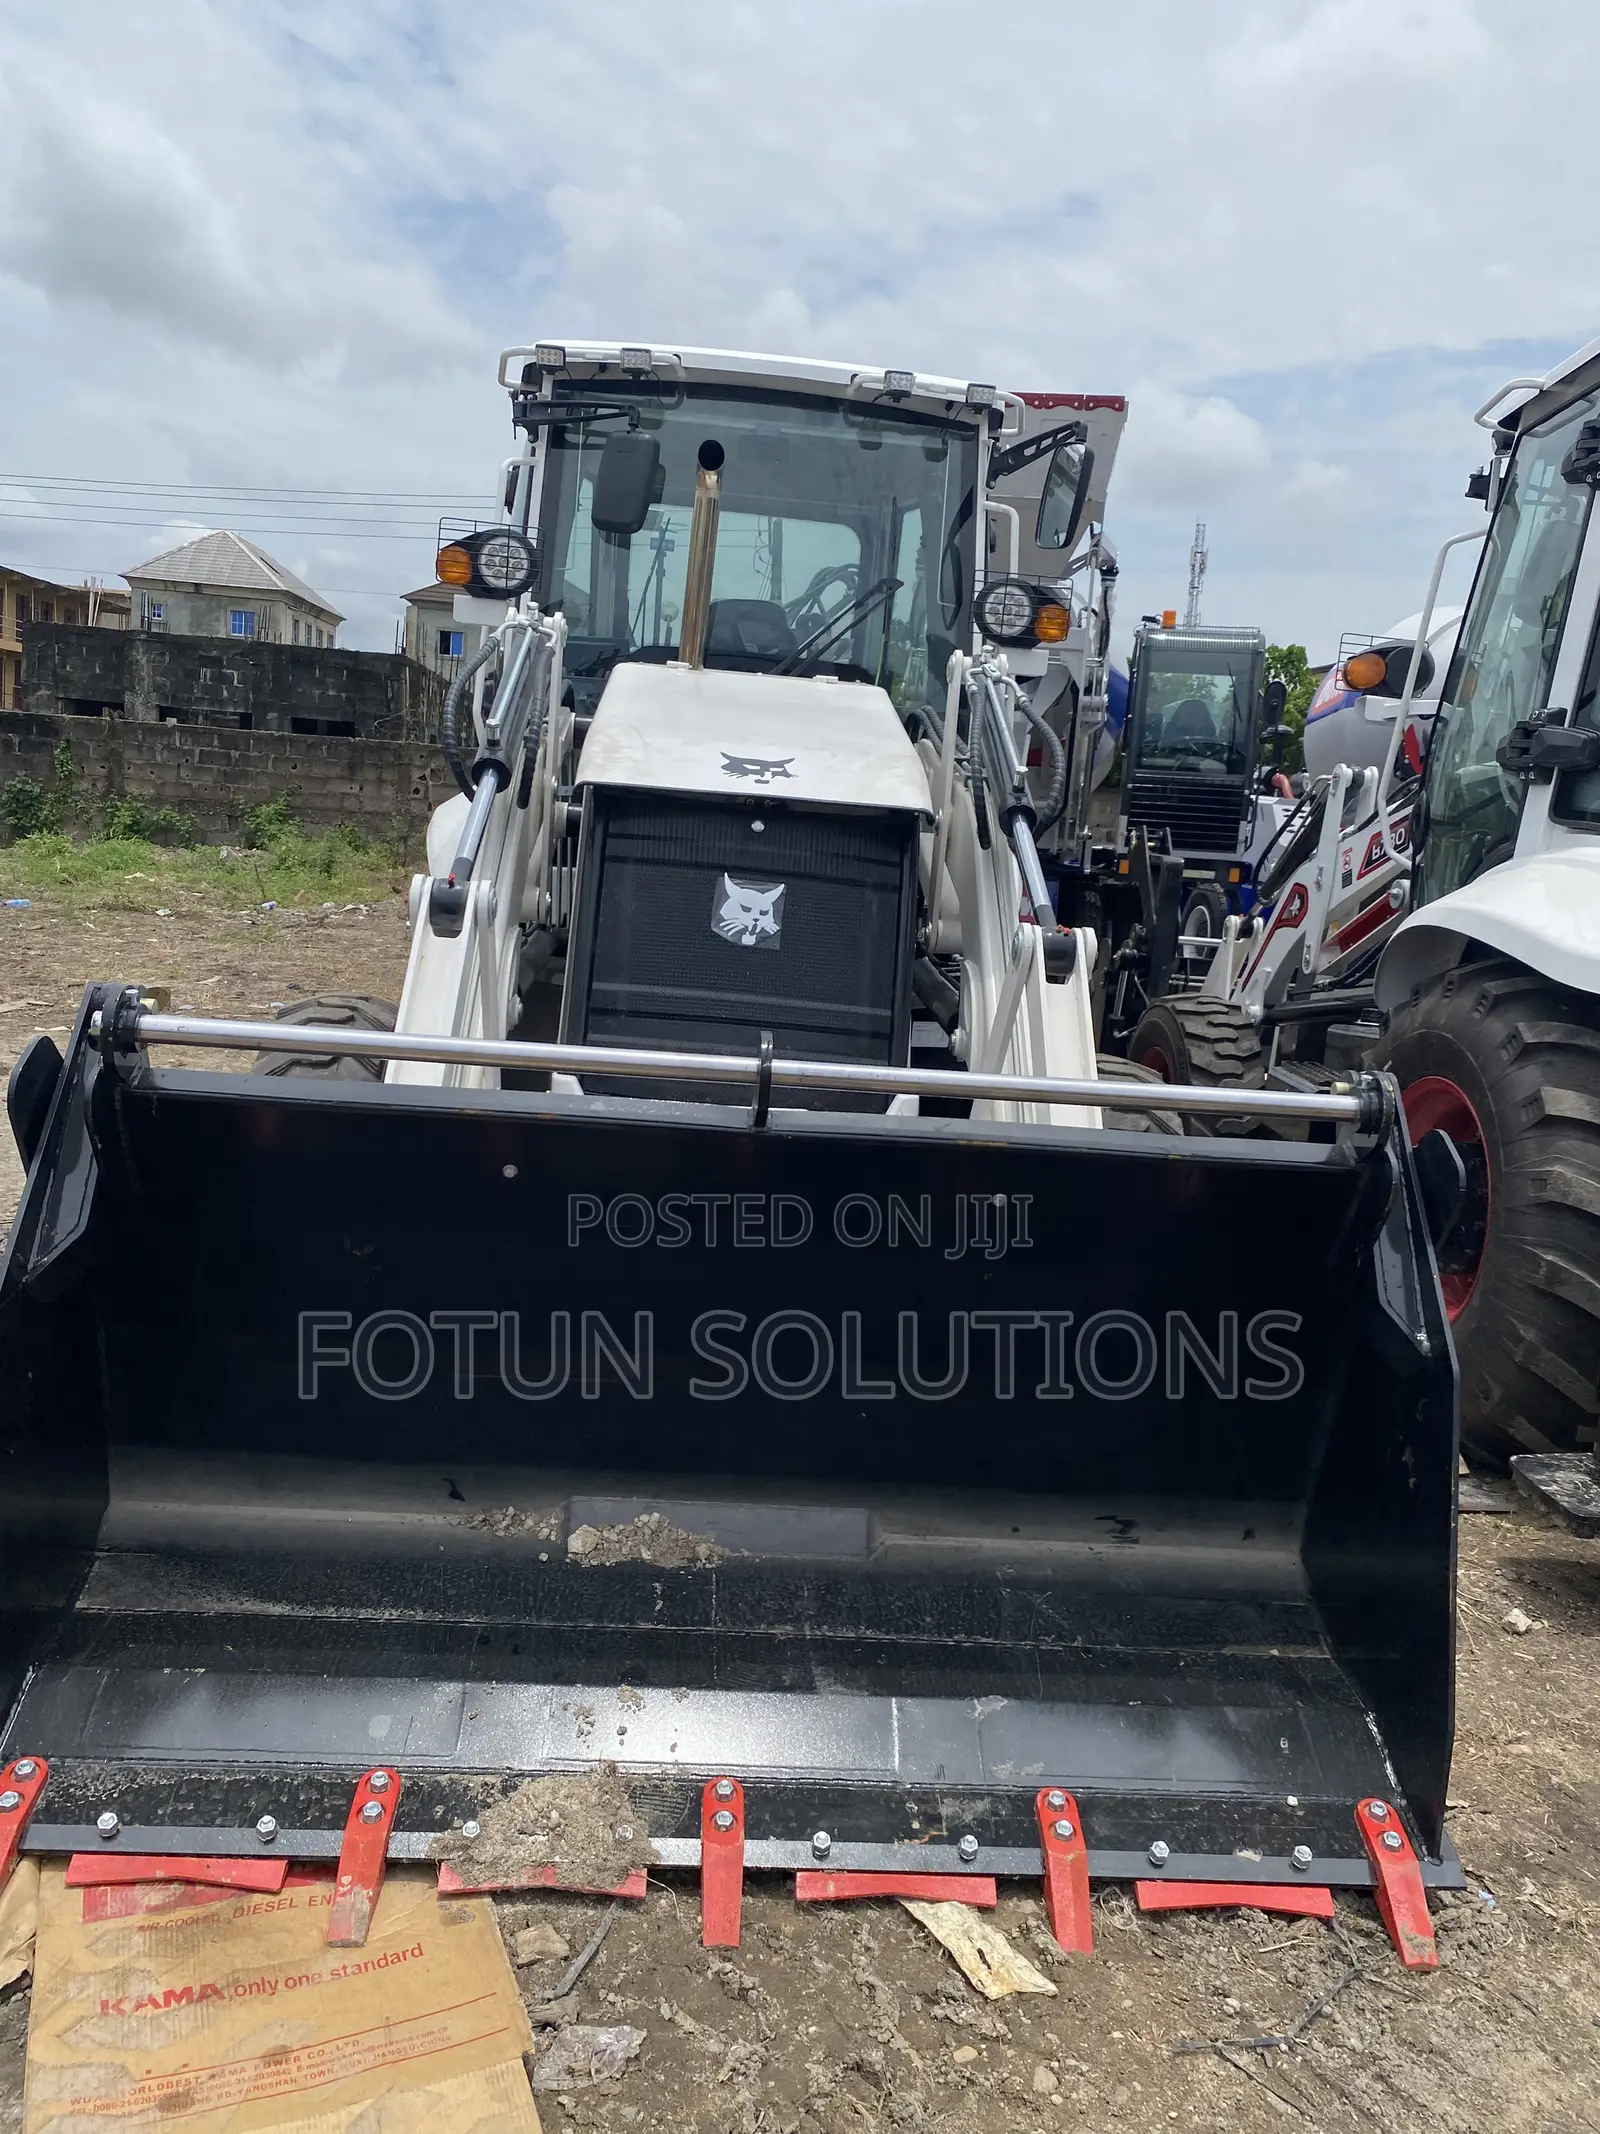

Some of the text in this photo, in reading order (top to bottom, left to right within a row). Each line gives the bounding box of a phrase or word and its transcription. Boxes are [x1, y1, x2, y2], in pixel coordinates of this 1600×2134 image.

[232, 1897, 299, 1919] DIESEL
[307, 1894, 334, 1907] EN
[284, 1971, 322, 1990] one
[329, 1942, 425, 1982] standard
[117, 2076, 201, 2099] ORLDBEST
[254, 2055, 301, 2071] POWER
